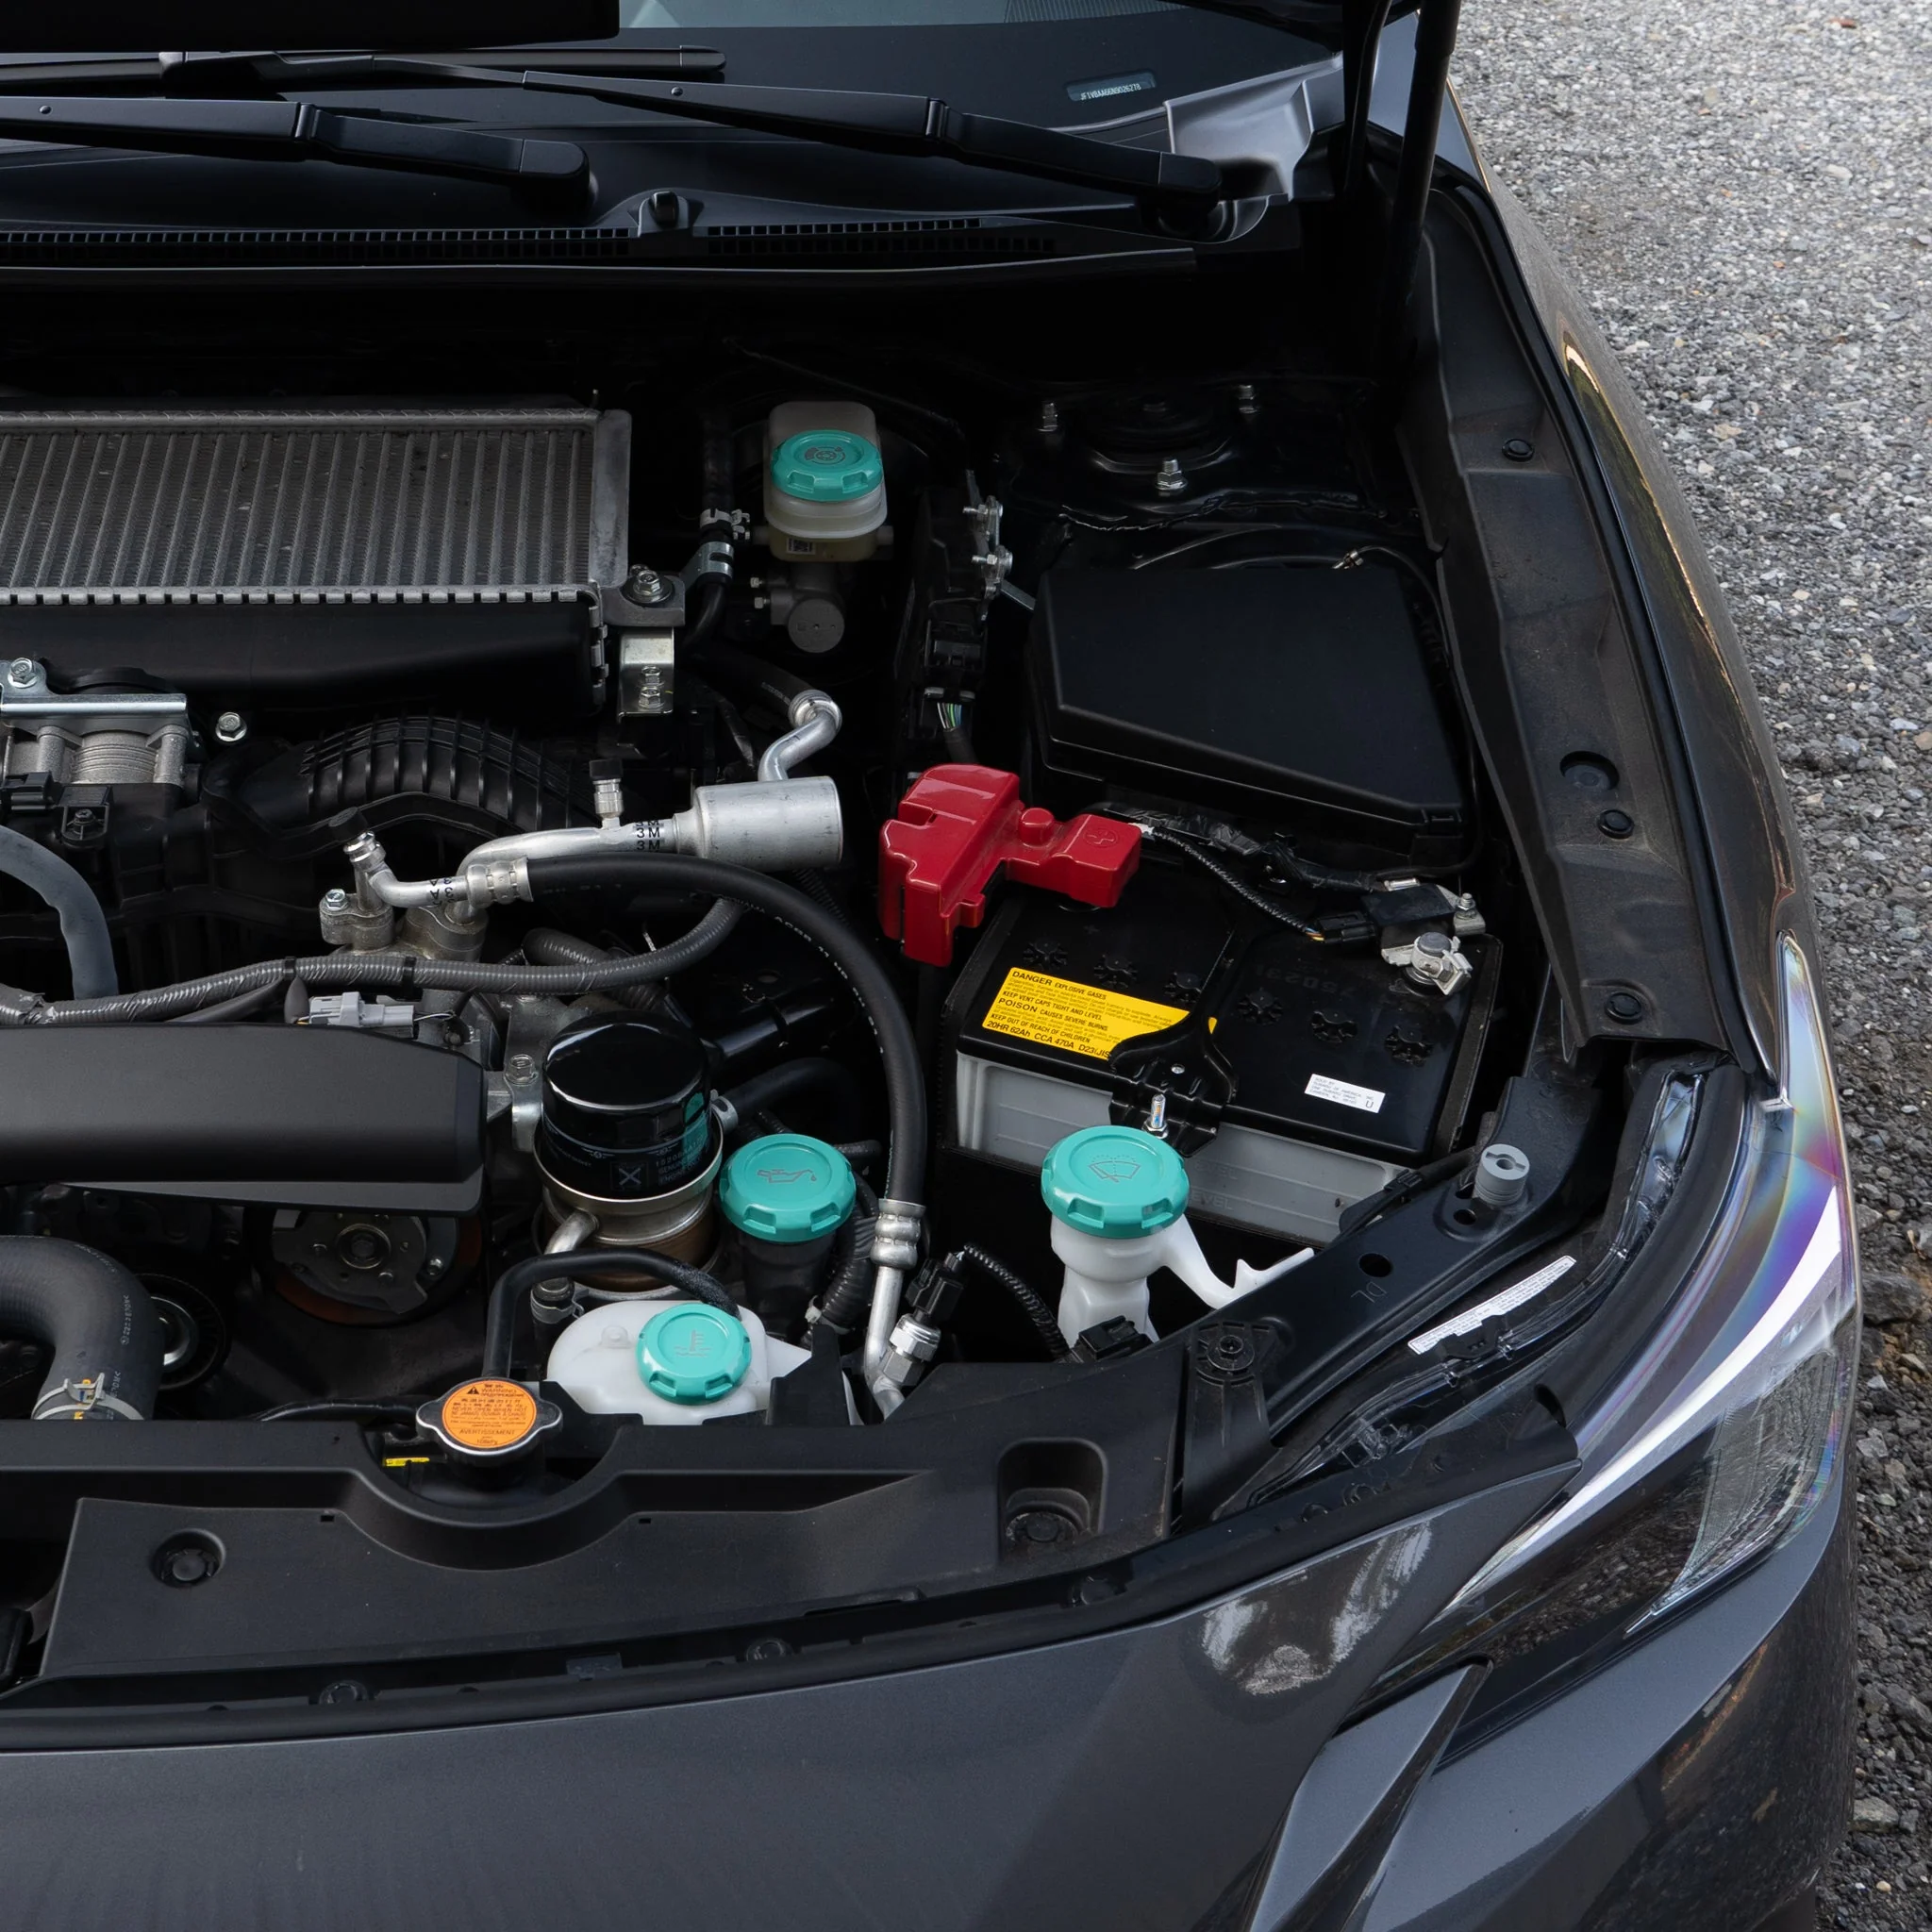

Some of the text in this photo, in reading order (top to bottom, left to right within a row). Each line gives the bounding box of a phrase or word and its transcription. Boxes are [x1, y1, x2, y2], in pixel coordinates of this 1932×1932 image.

[1012, 971, 1053, 987] DANGER
[1055, 982, 1086, 995] EXPLOSIVE
[998, 997, 1038, 1013] POISON
[1040, 1008, 1063, 1020] CAUSES
[1064, 1015, 1087, 1026] SEVERE
[1088, 1021, 1108, 1032] BURNS
[1003, 990, 1018, 999] KEEP
[1019, 994, 1034, 1003] VENT
[1035, 998, 1051, 1008] CAPS
[1052, 1003, 1069, 1012] TIGHT
[1071, 1008, 1084, 1016] AND
[1084, 1011, 1103, 1021] LEVEL
[987, 1020, 1009, 1032] 20HR
[1009, 1025, 1031, 1038] 62Ah
[1034, 1032, 1054, 1043] CCA
[1054, 1038, 1075, 1049] 470A
[991, 1013, 1007, 1022] KEEP
[1007, 1017, 1019, 1025] OUT
[1029, 1023, 1050, 1033] REACH
[1060, 1030, 1091, 1043] CHILDREN
